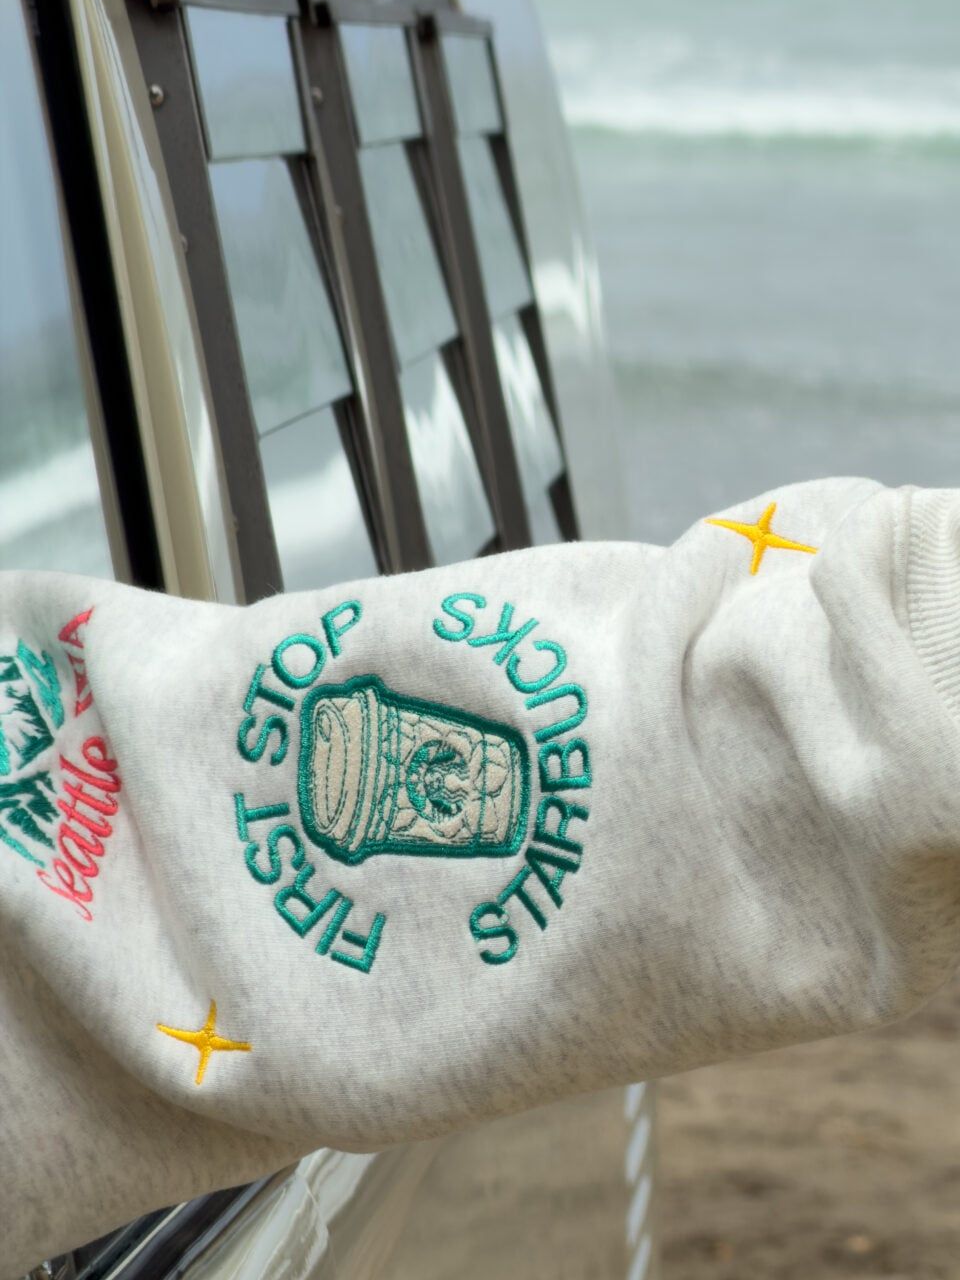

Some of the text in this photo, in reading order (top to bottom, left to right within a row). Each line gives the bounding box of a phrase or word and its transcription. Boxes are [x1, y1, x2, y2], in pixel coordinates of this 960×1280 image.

[232, 599, 387, 975] FIRST STOP
[431, 591, 594, 966] STARBUCKS
